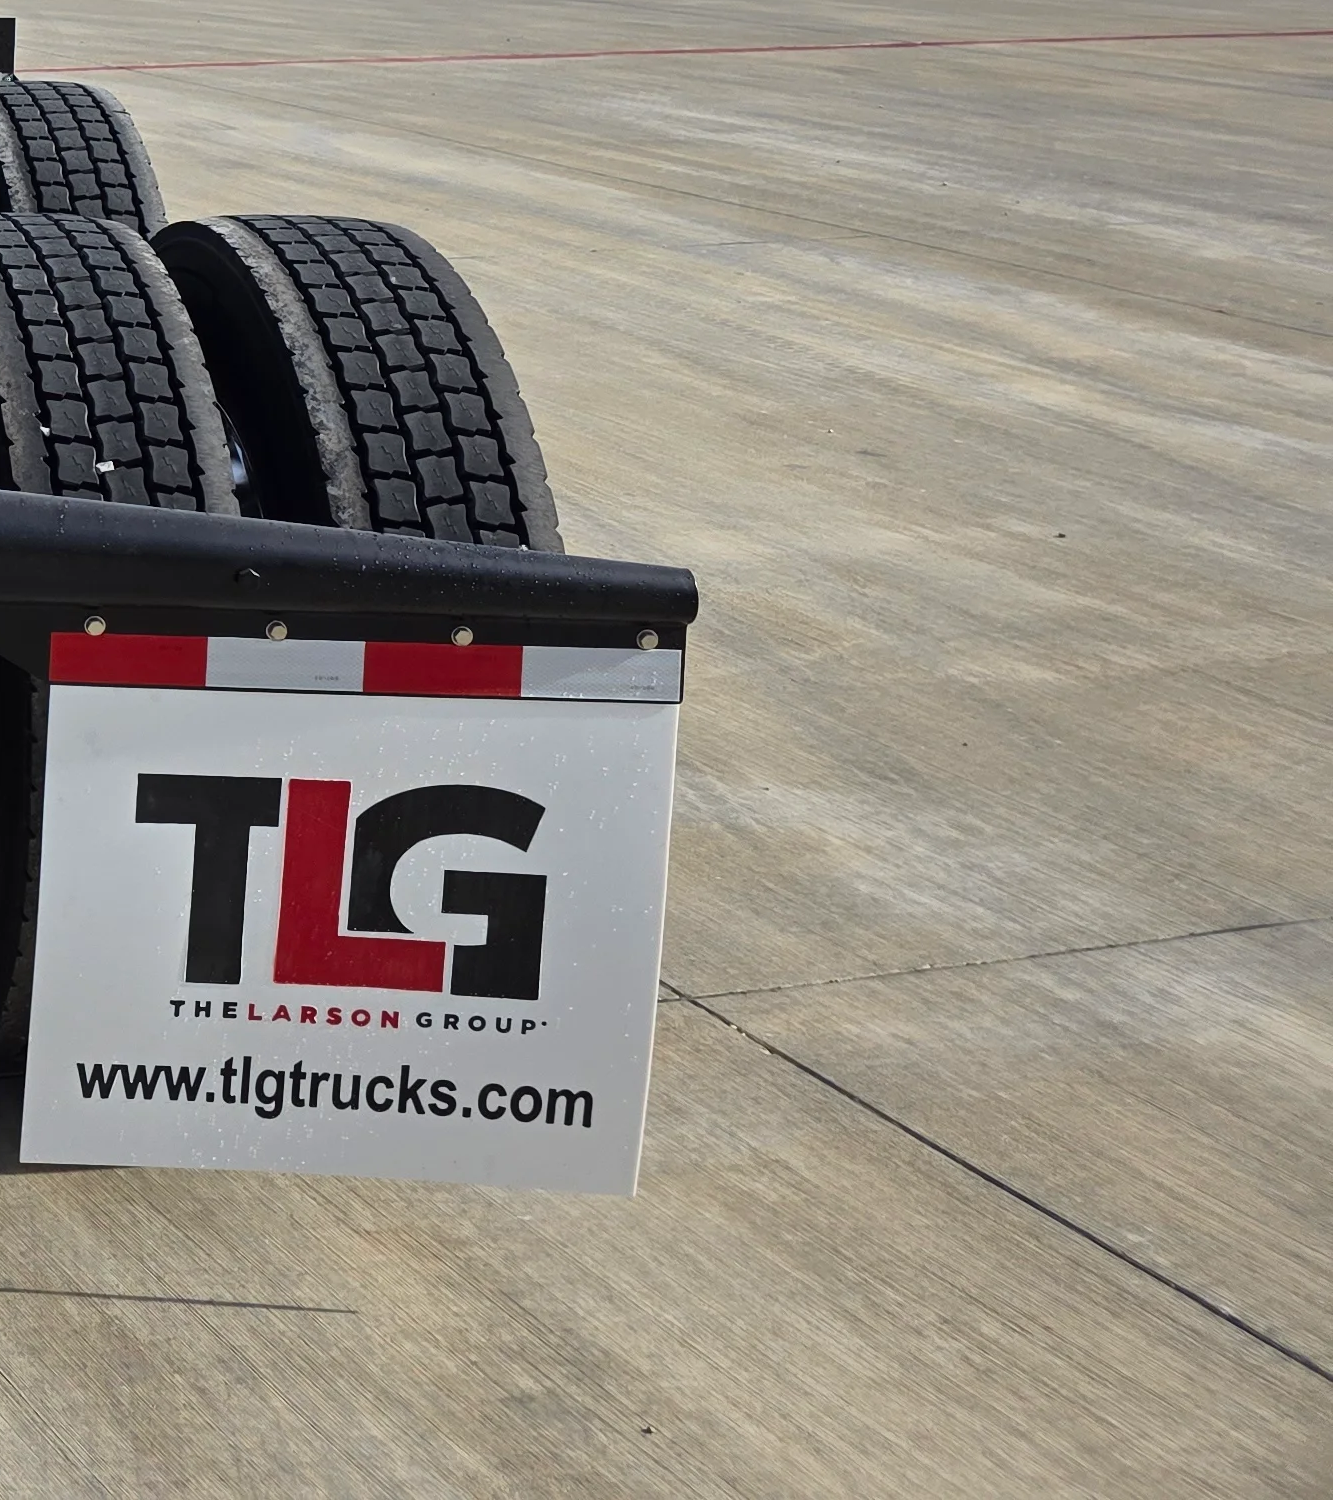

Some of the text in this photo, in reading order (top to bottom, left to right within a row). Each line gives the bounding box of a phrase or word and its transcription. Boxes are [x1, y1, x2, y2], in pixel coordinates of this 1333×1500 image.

[135, 773, 547, 1001] TLG
[415, 1011, 537, 1035] GROUP
[76, 1056, 594, 1129] www.tlgtrucks.com
